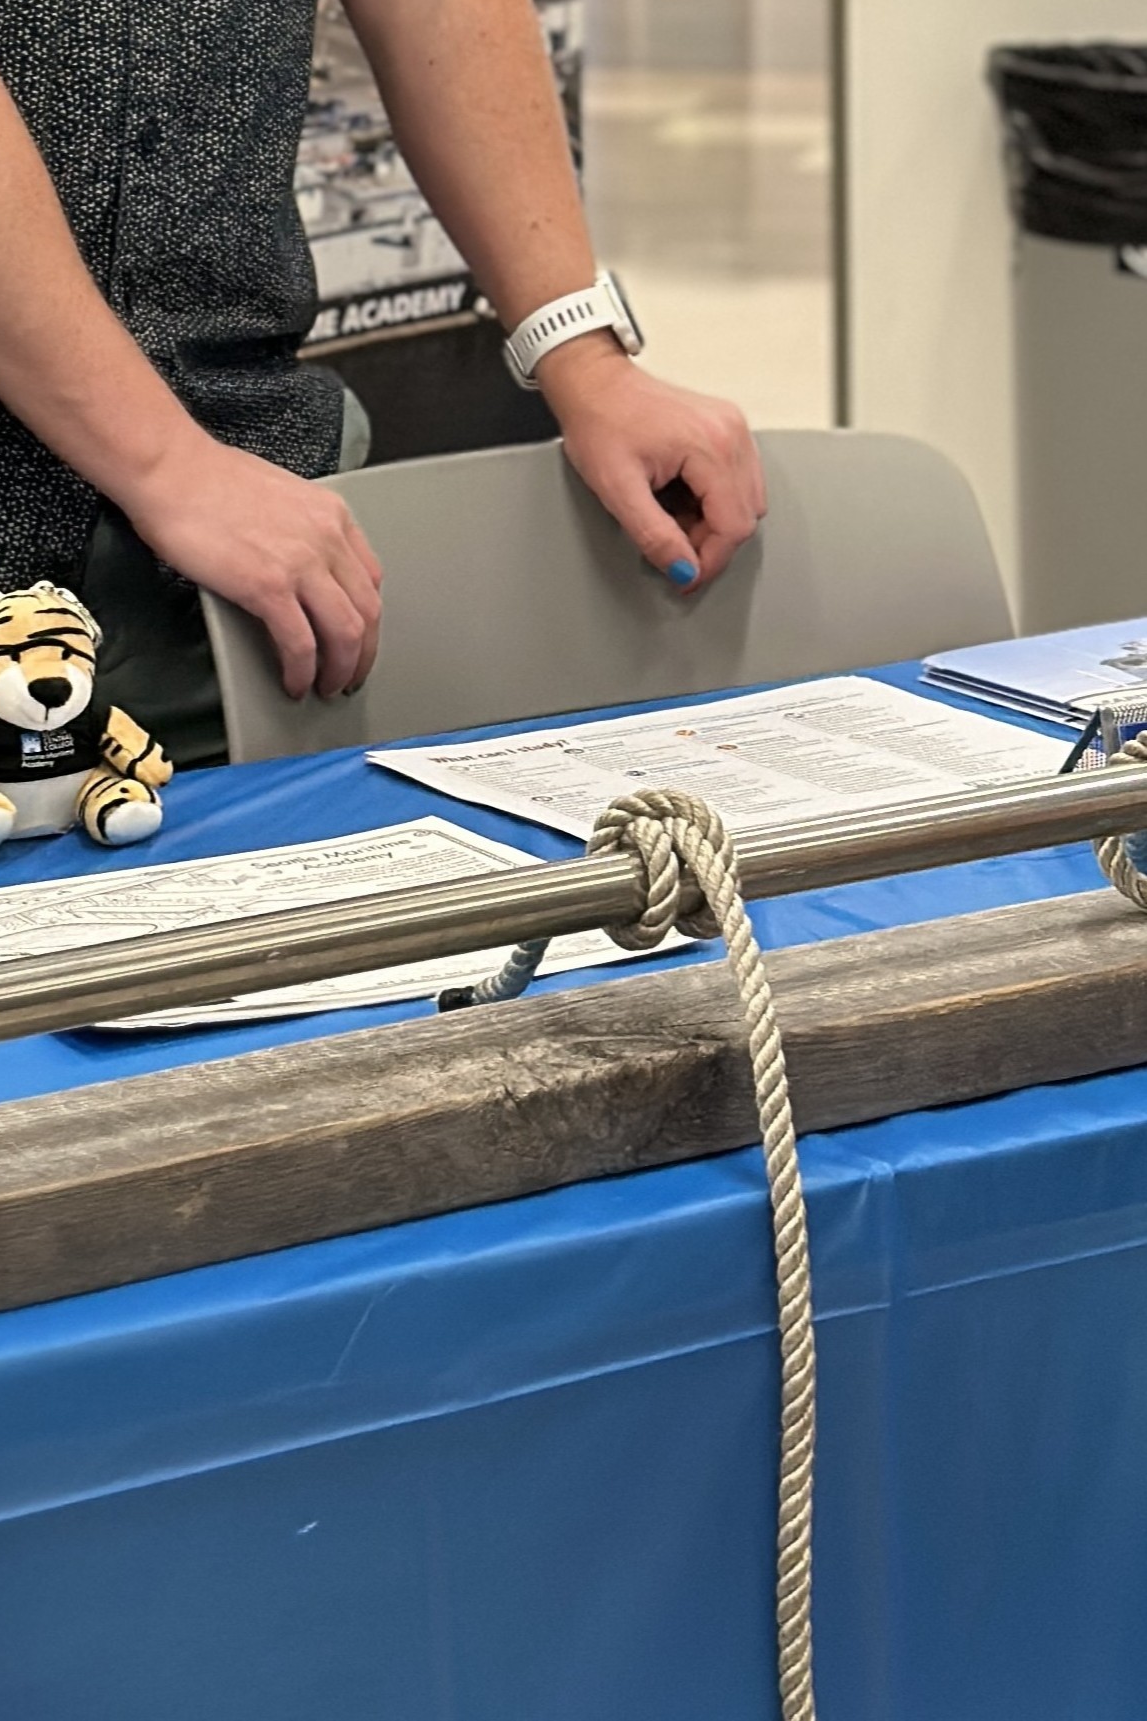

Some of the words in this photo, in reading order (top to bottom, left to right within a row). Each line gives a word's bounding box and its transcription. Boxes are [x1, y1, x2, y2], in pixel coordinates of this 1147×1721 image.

[341, 281, 466, 335] ACADEMY
[428, 753, 474, 764] What
[478, 749, 505, 759] can
[518, 739, 570, 754] study?
[251, 856, 319, 870] Seattle
[322, 838, 412, 859] Maritime
[302, 851, 394, 871] Academy
